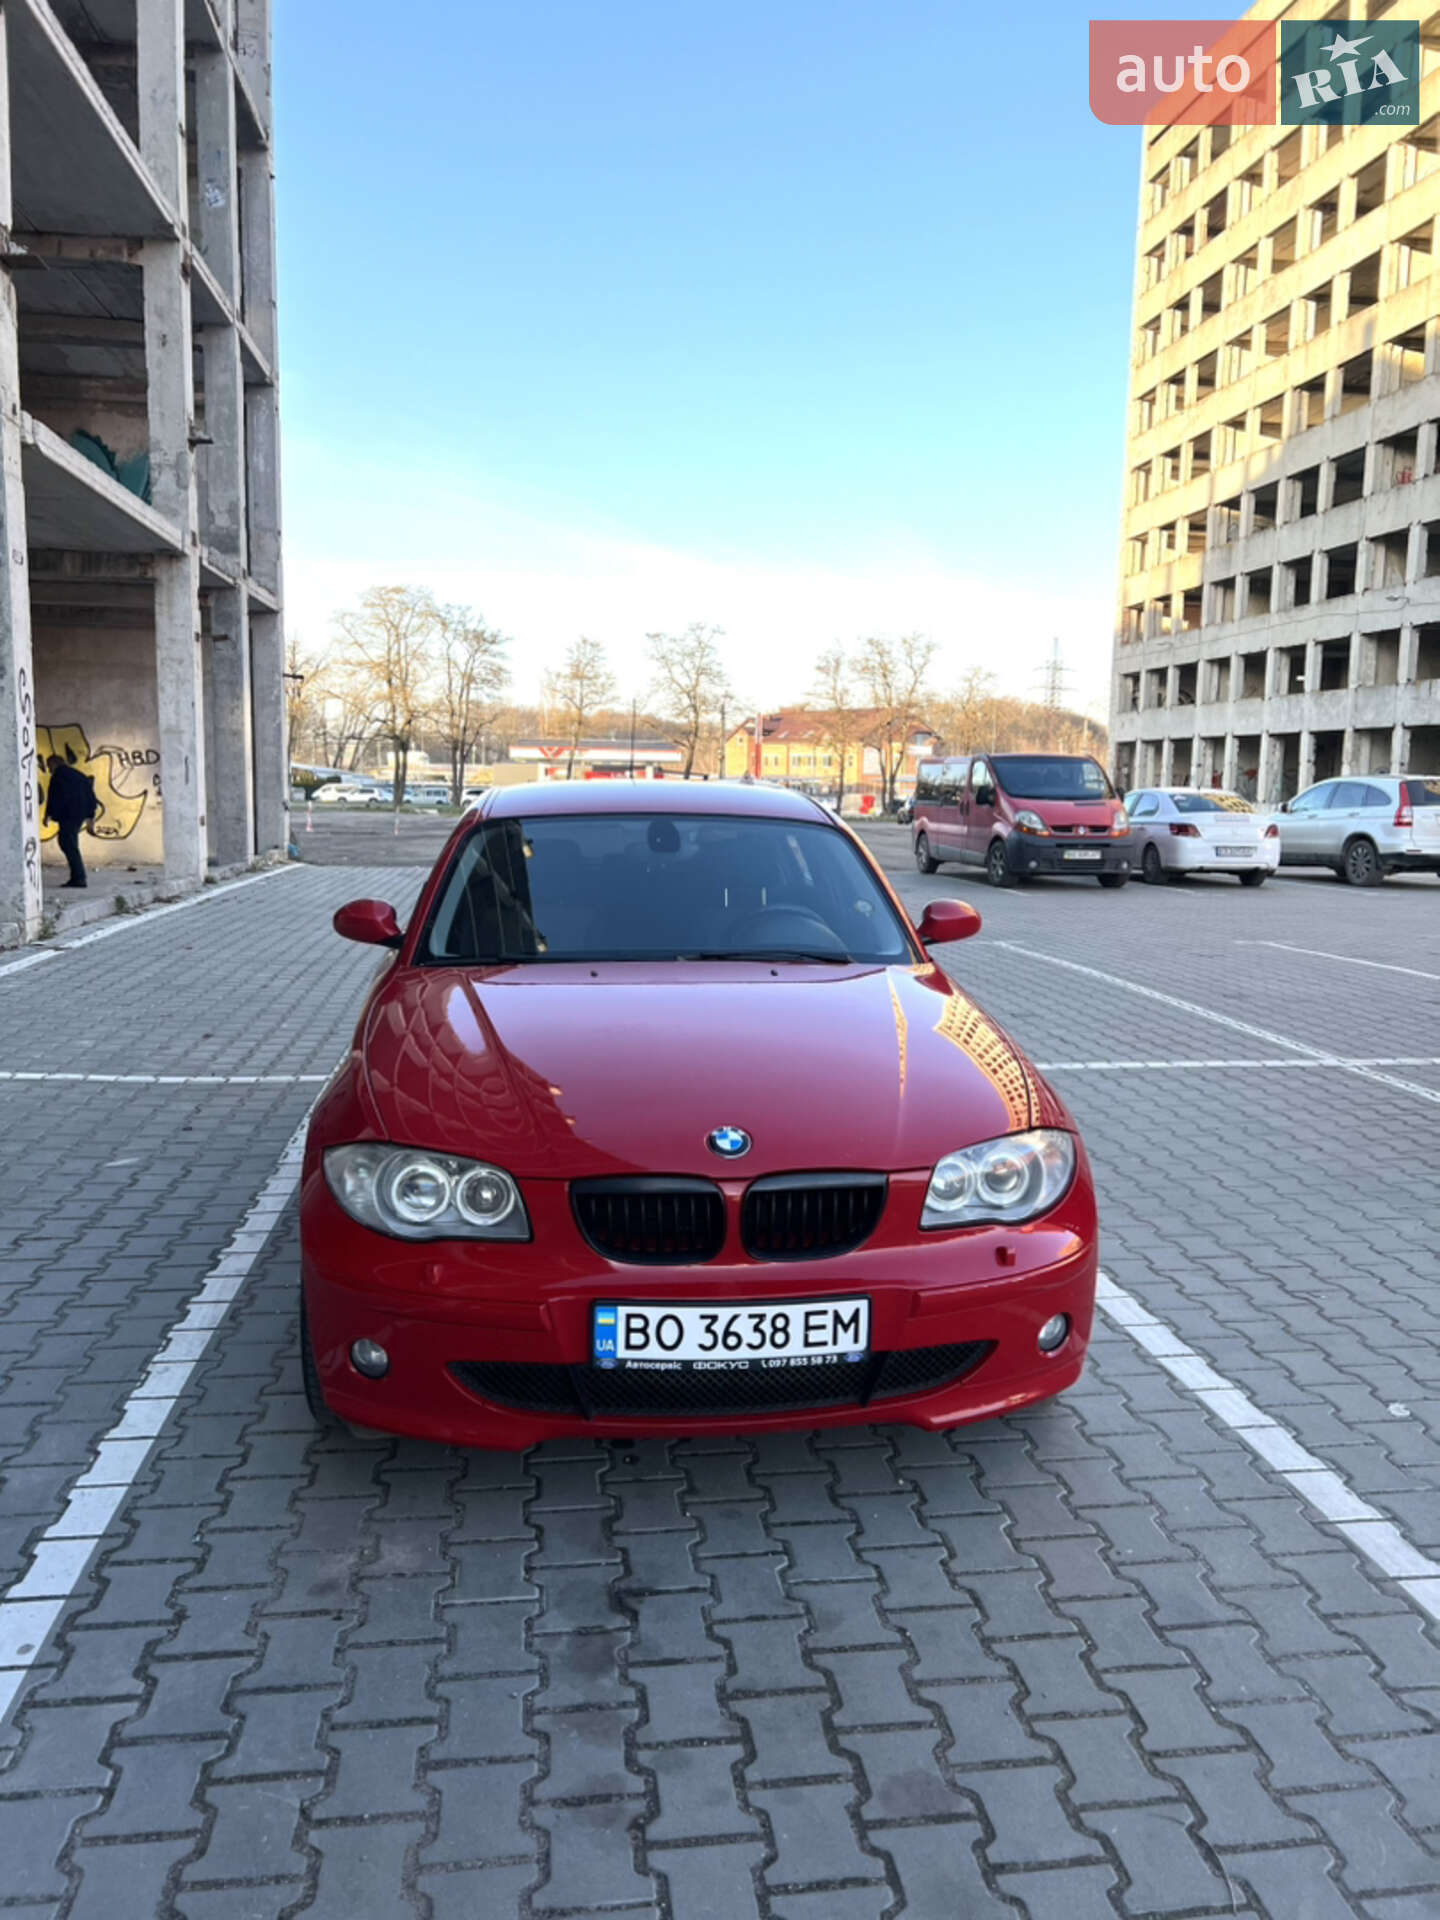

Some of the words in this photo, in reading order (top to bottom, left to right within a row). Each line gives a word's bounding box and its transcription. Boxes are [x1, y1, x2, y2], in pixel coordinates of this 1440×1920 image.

[624, 1313, 684, 1351] BO
[697, 1312, 790, 1351] 3638
[803, 1307, 860, 1349] EM
[596, 1339, 614, 1352] UA
